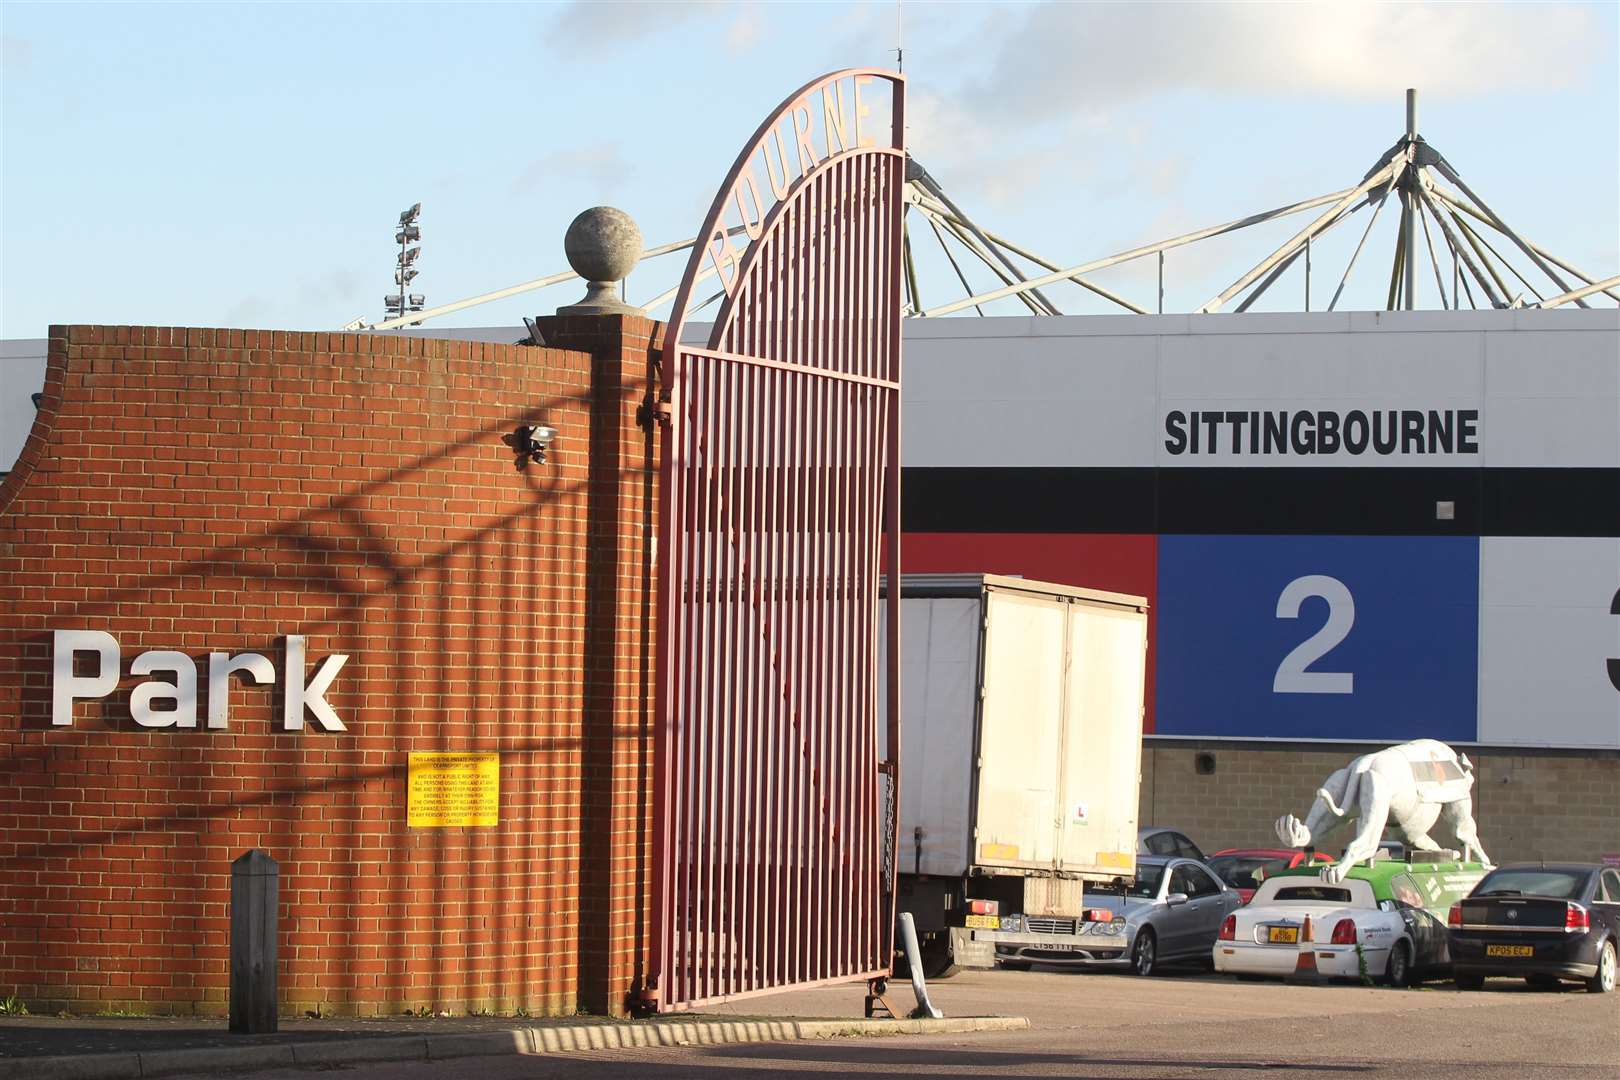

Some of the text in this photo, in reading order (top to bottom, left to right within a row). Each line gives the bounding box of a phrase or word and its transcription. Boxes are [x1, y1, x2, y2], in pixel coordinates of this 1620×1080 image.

[707, 75, 876, 300] BOURNE
[1164, 410, 1479, 455] SITTINGBOURNE
[52, 630, 349, 731] Park
[1273, 575, 1355, 694] 2
